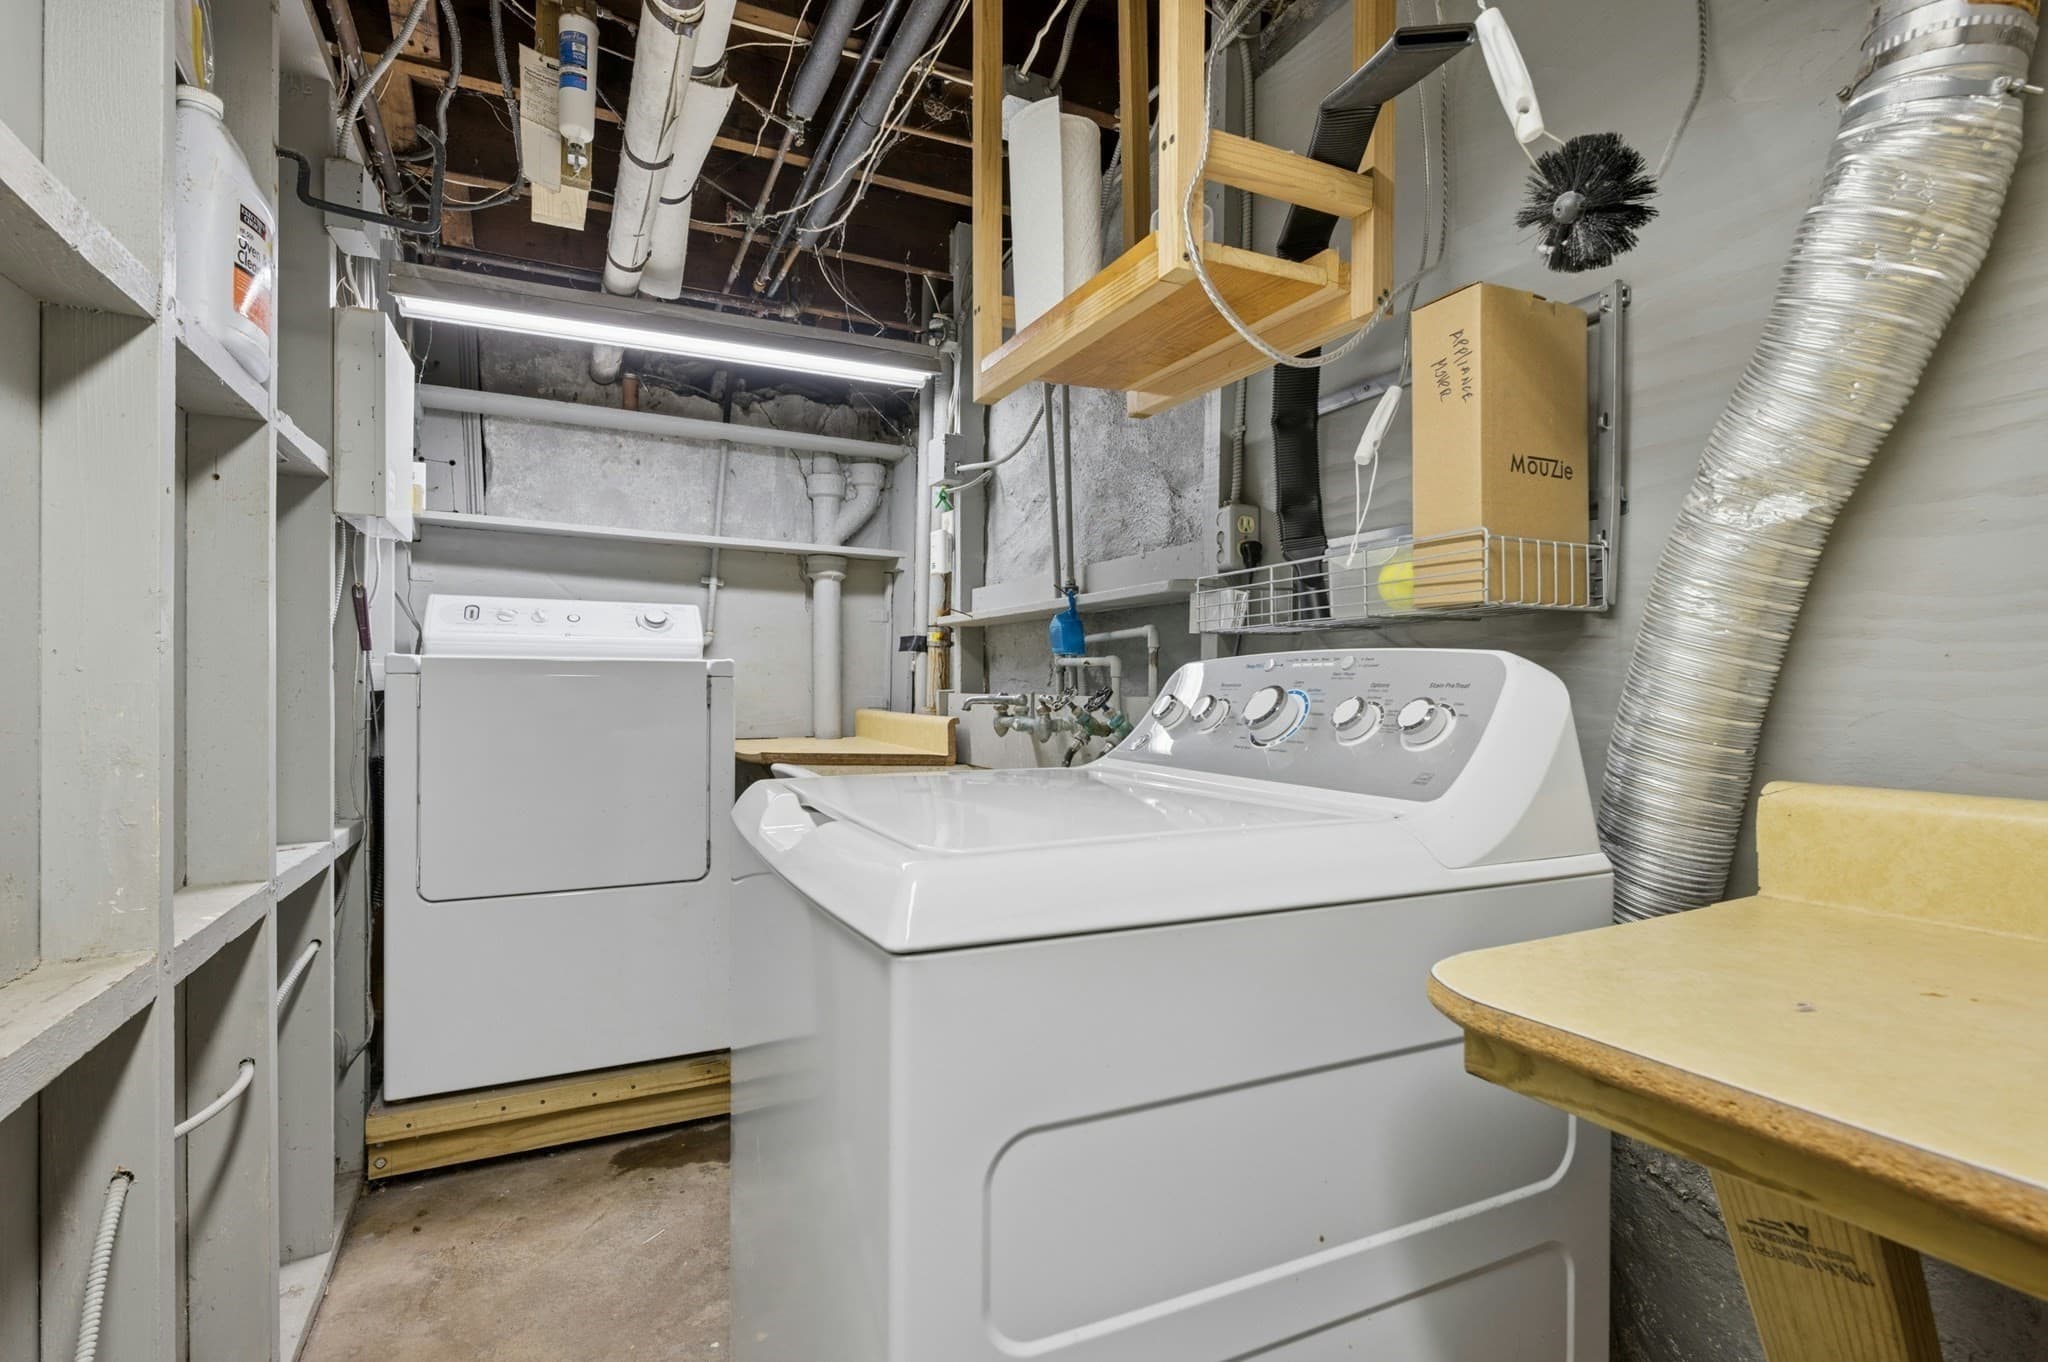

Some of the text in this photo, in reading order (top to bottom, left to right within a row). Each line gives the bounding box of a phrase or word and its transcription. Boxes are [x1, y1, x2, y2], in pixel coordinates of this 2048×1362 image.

[1431, 357, 1452, 402] MOVER
[1449, 328, 1473, 404] APPLIANCE
[1510, 454, 1574, 481] MouZie
